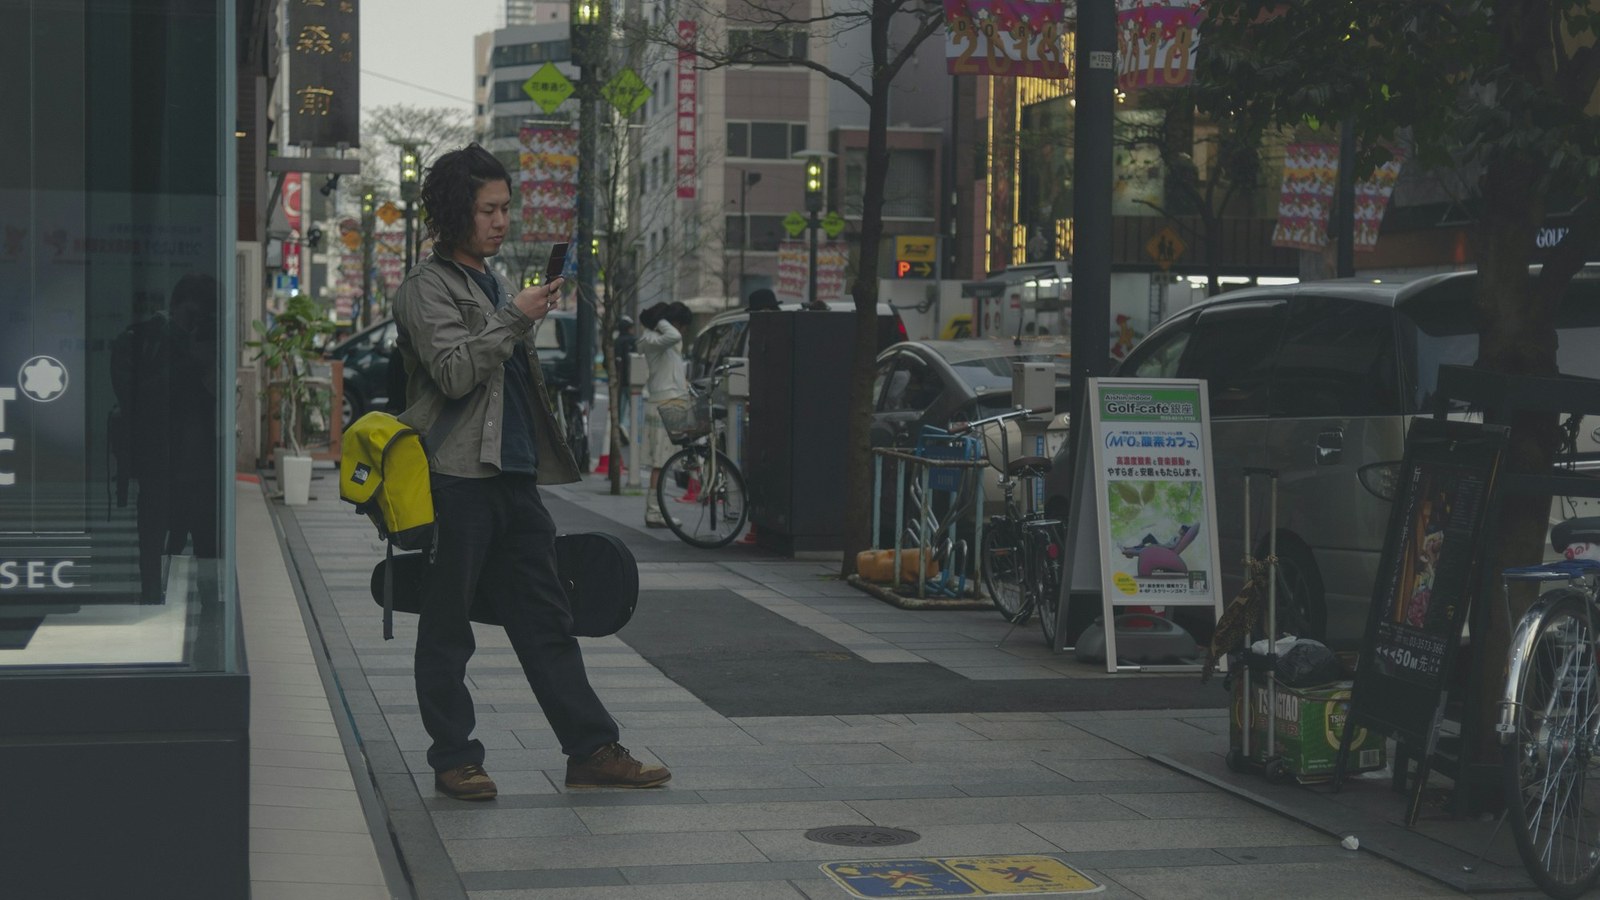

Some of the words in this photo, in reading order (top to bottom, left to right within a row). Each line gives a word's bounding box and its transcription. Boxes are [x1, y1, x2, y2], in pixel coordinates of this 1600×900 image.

[953, 17, 1060, 74] 2018
[898, 261, 910, 278] P
[1258, 688, 1298, 722] TSGTAO
